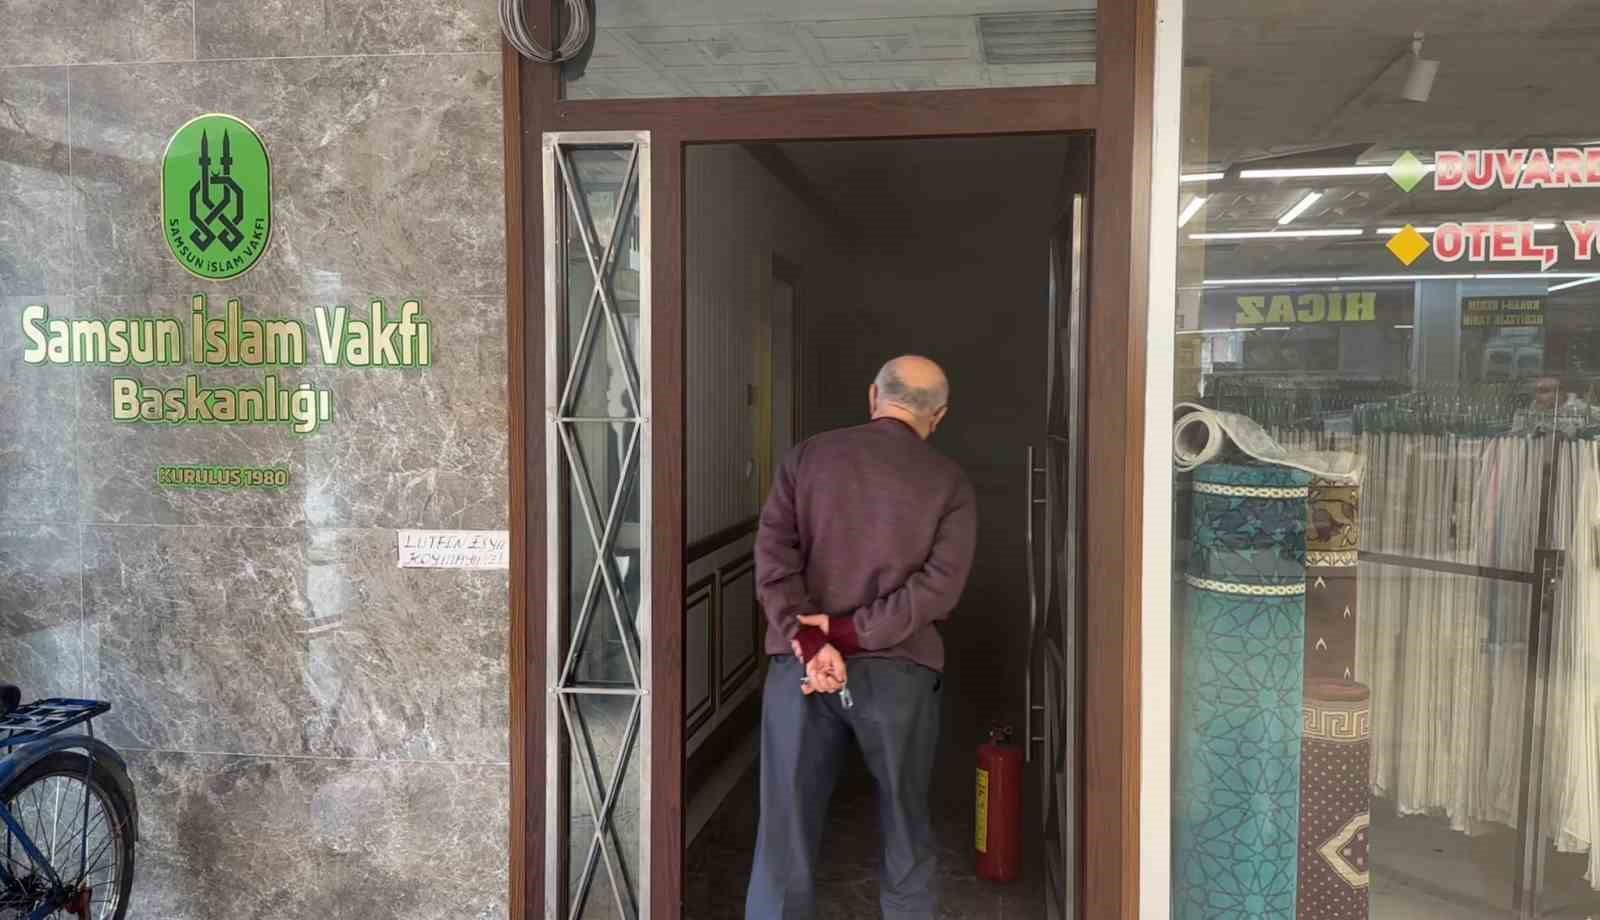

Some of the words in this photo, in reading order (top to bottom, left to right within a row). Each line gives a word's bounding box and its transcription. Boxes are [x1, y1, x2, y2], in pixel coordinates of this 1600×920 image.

[169, 218, 204, 269] SAMSUN
[207, 256, 245, 273] İSLAM
[243, 218, 265, 257] VAKFI
[1433, 222, 1558, 272] OTEL,
[1564, 220, 1600, 261] Y
[21, 304, 181, 366] Samsun
[191, 294, 306, 366] İslam
[313, 300, 431, 367] Vakfı
[112, 376, 333, 433] Başkanlığı
[244, 469, 287, 486] 1980
